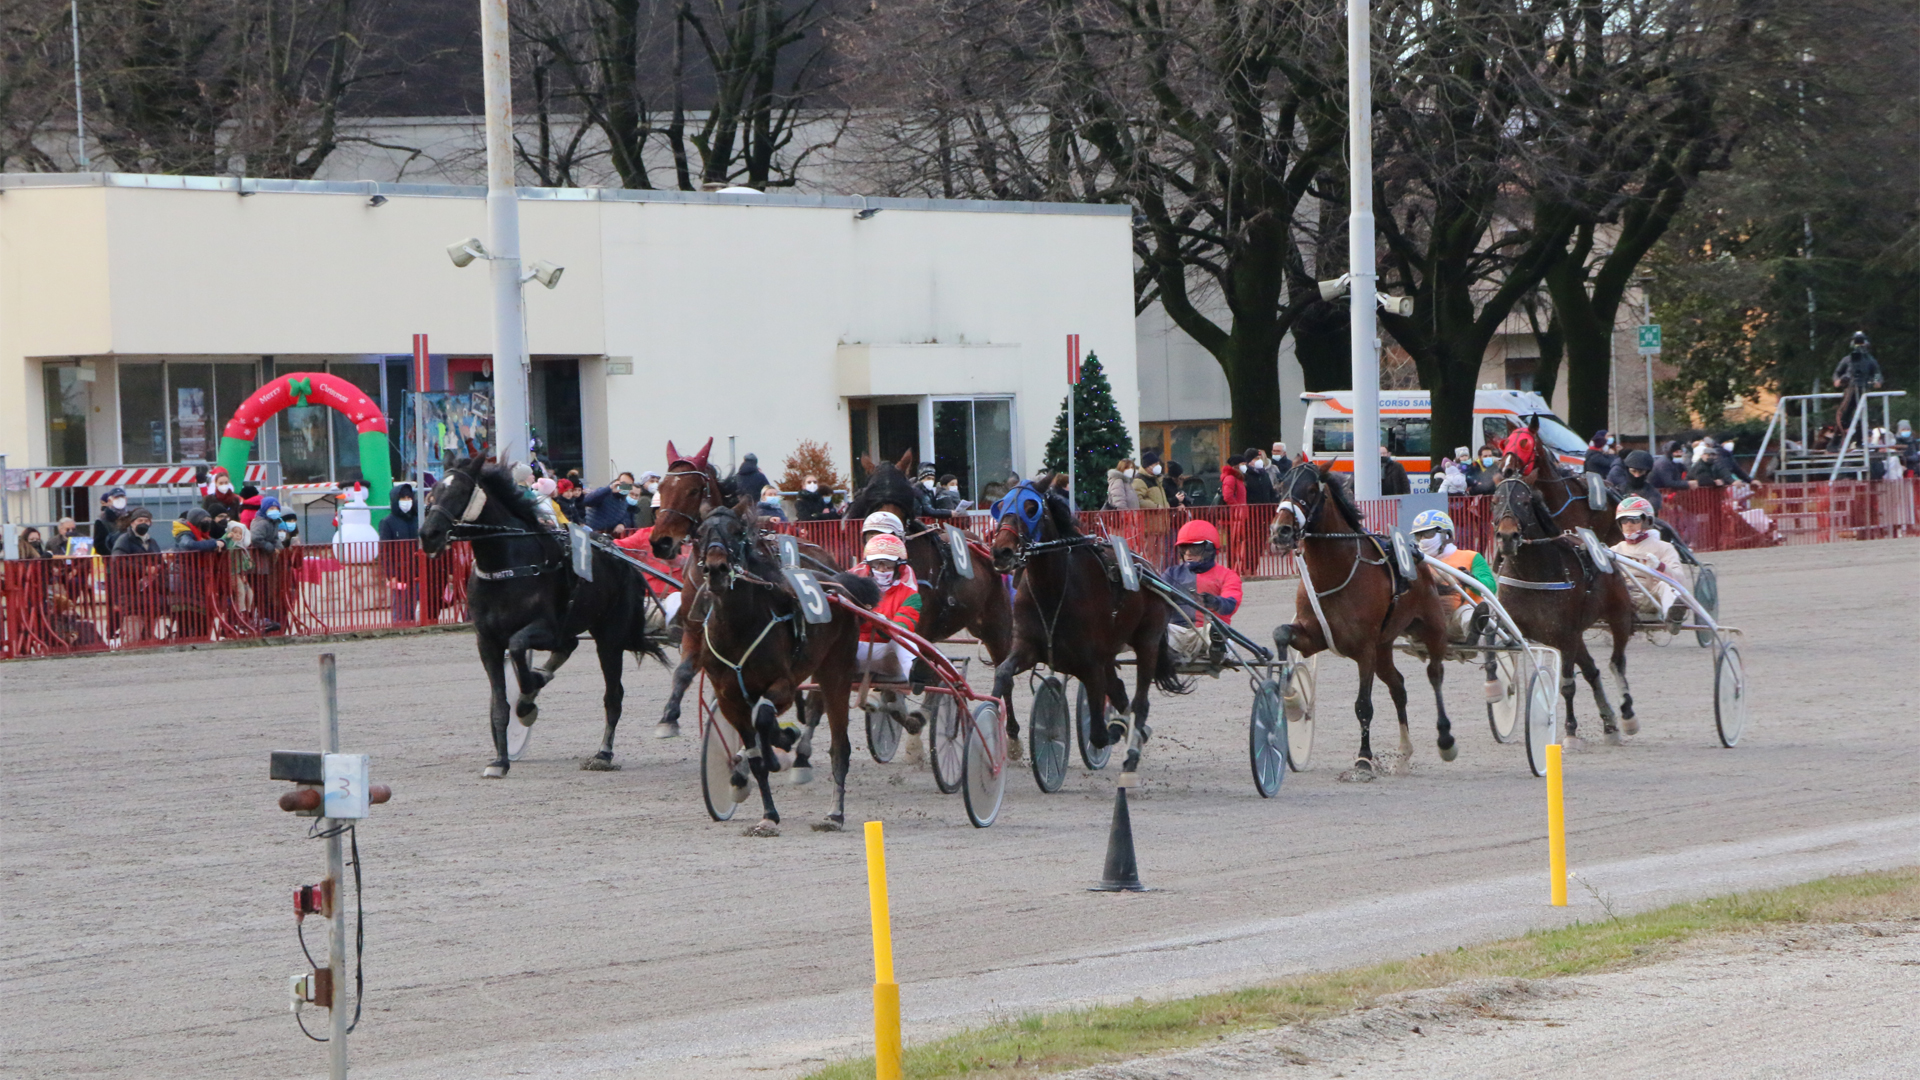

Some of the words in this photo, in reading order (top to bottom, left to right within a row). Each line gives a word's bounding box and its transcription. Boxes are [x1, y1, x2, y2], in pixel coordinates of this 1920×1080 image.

[259, 386, 281, 405] Merry
[1593, 476, 1602, 505] 1
[574, 529, 587, 570] 7
[952, 530, 967, 570] 9
[1119, 541, 1134, 584] 4
[1395, 531, 1410, 571] 6
[1584, 532, 1607, 566] 8
[793, 573, 823, 615] 5
[338, 776, 351, 799] 3
